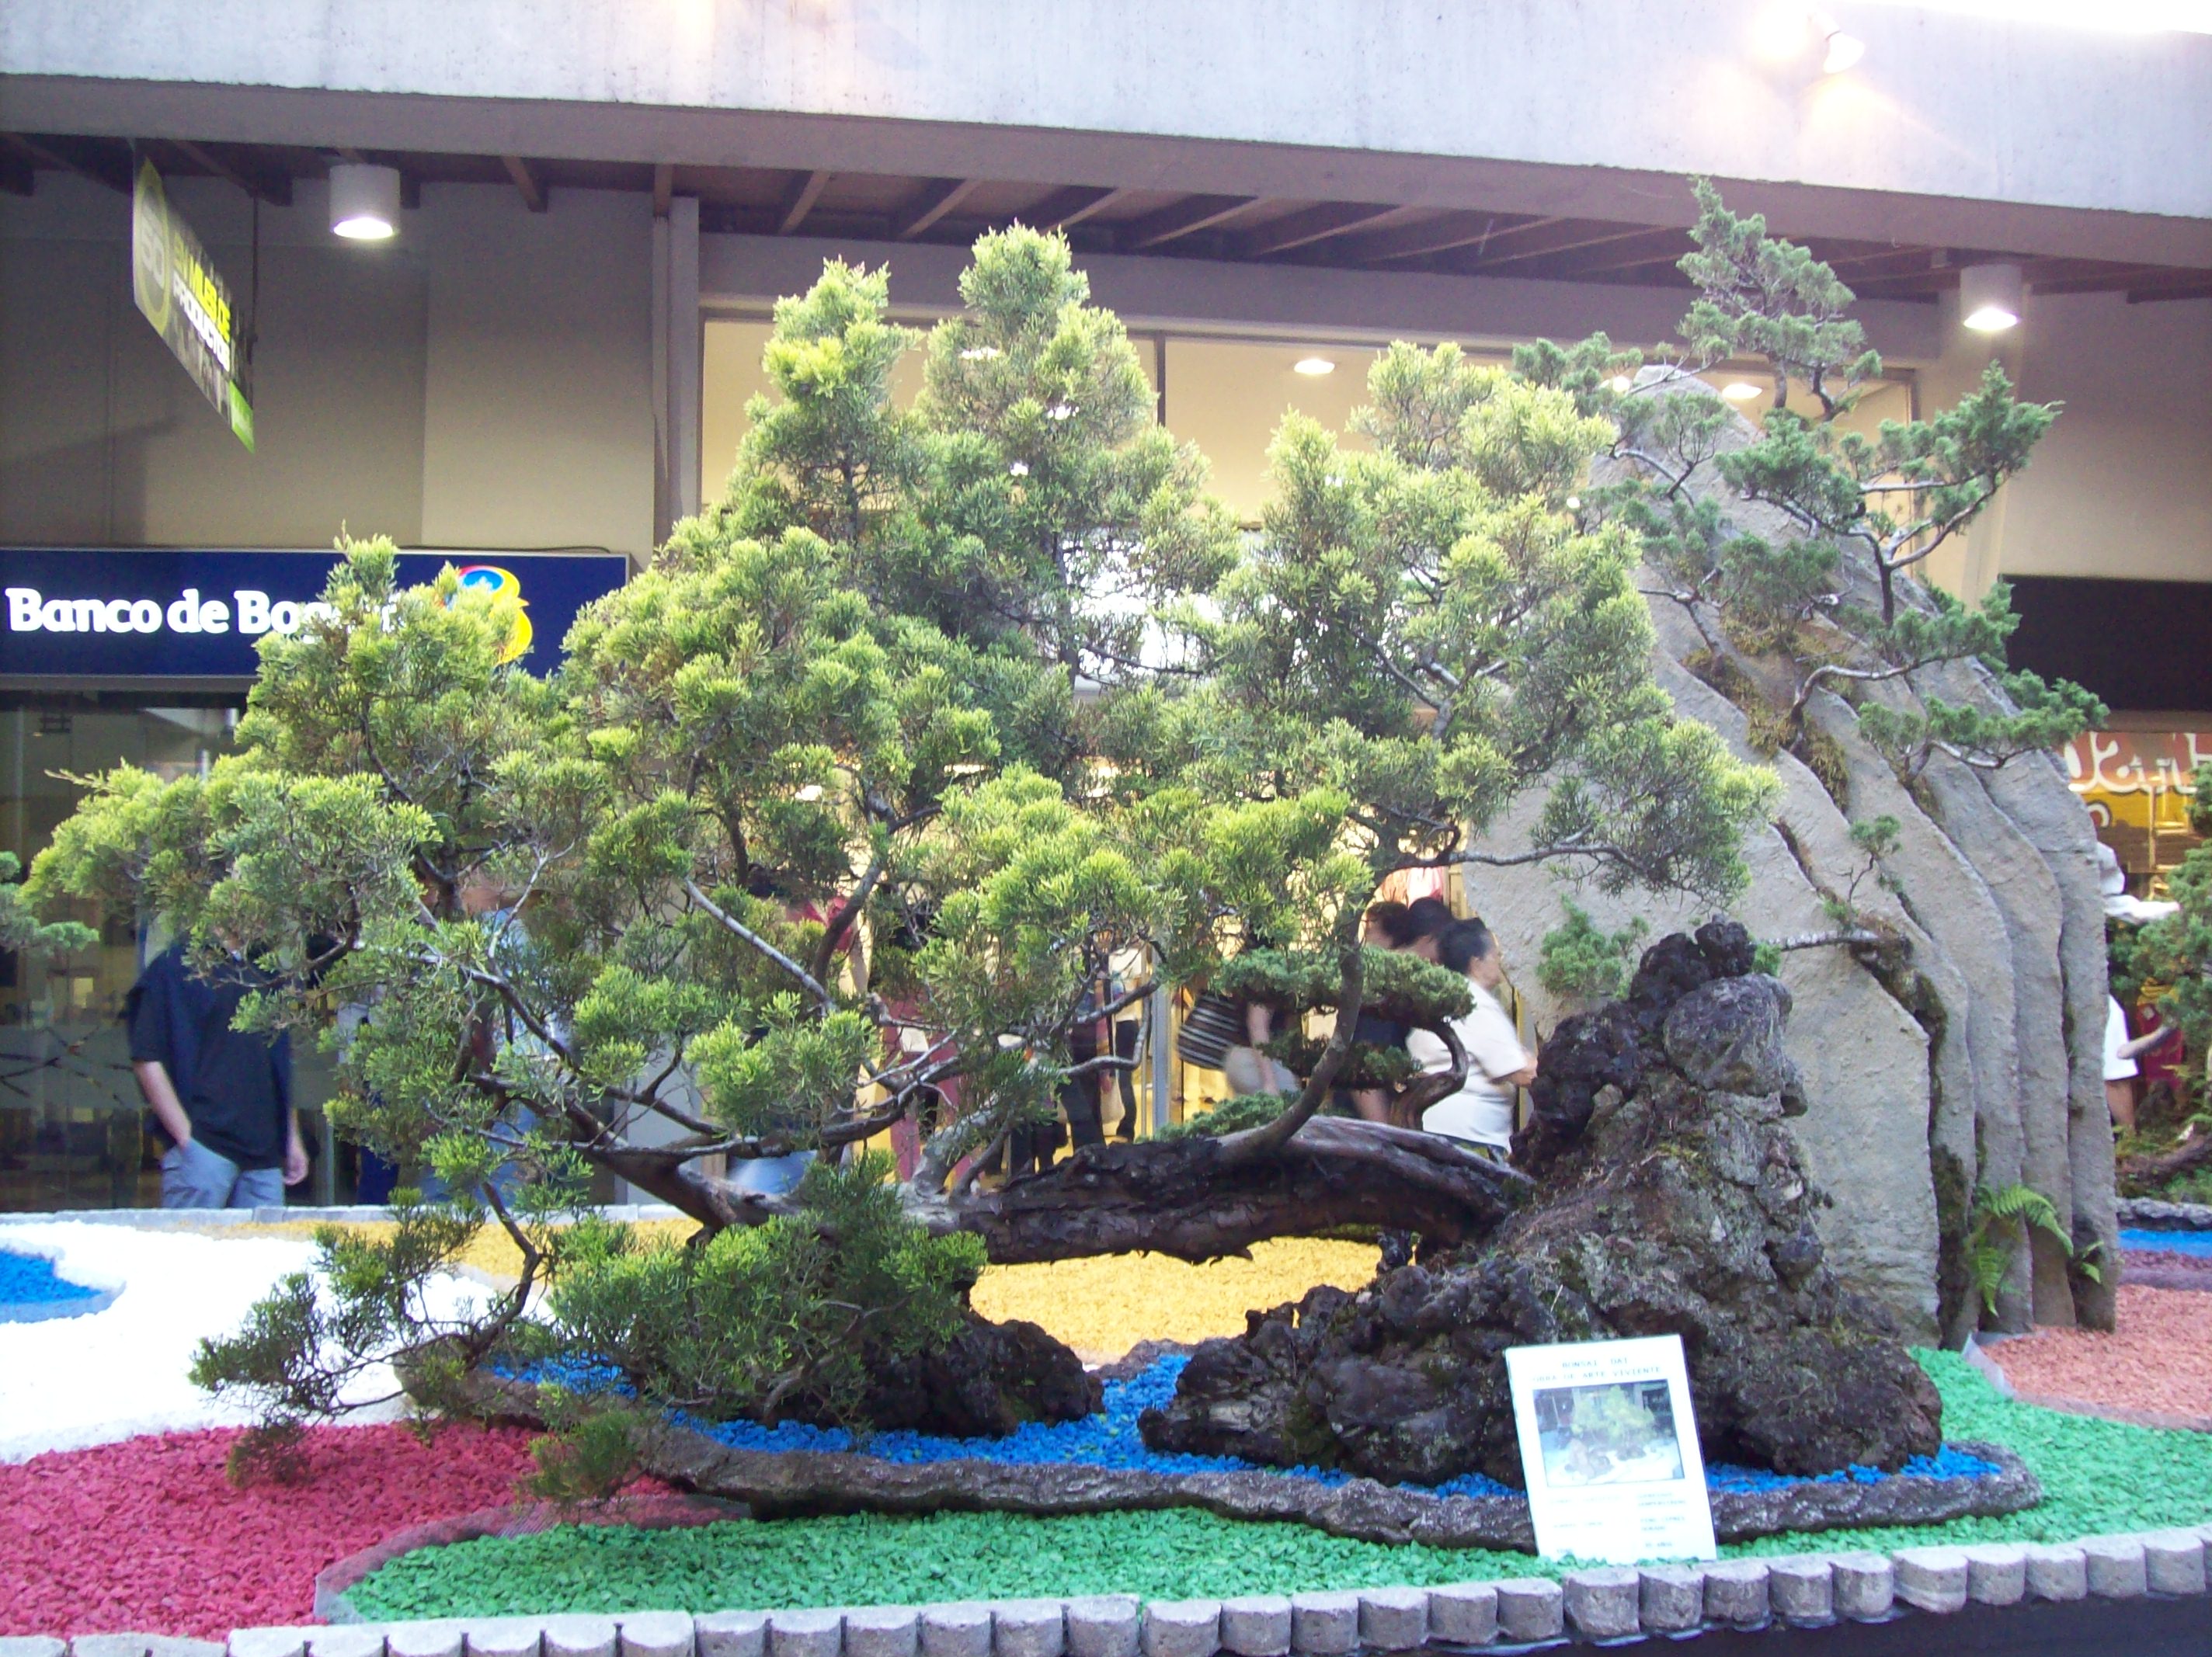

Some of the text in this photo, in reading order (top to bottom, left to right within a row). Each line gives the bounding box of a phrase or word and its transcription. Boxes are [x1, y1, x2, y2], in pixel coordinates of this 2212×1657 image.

[173, 269, 231, 372] PRODUCTOS
[5, 587, 162, 634] Banco
[166, 588, 229, 634] de
[1533, 1374, 1557, 1383] OBRA
[1612, 1367, 1661, 1377] VIVIENTE
[1562, 1359, 1598, 1368] BONSAI
